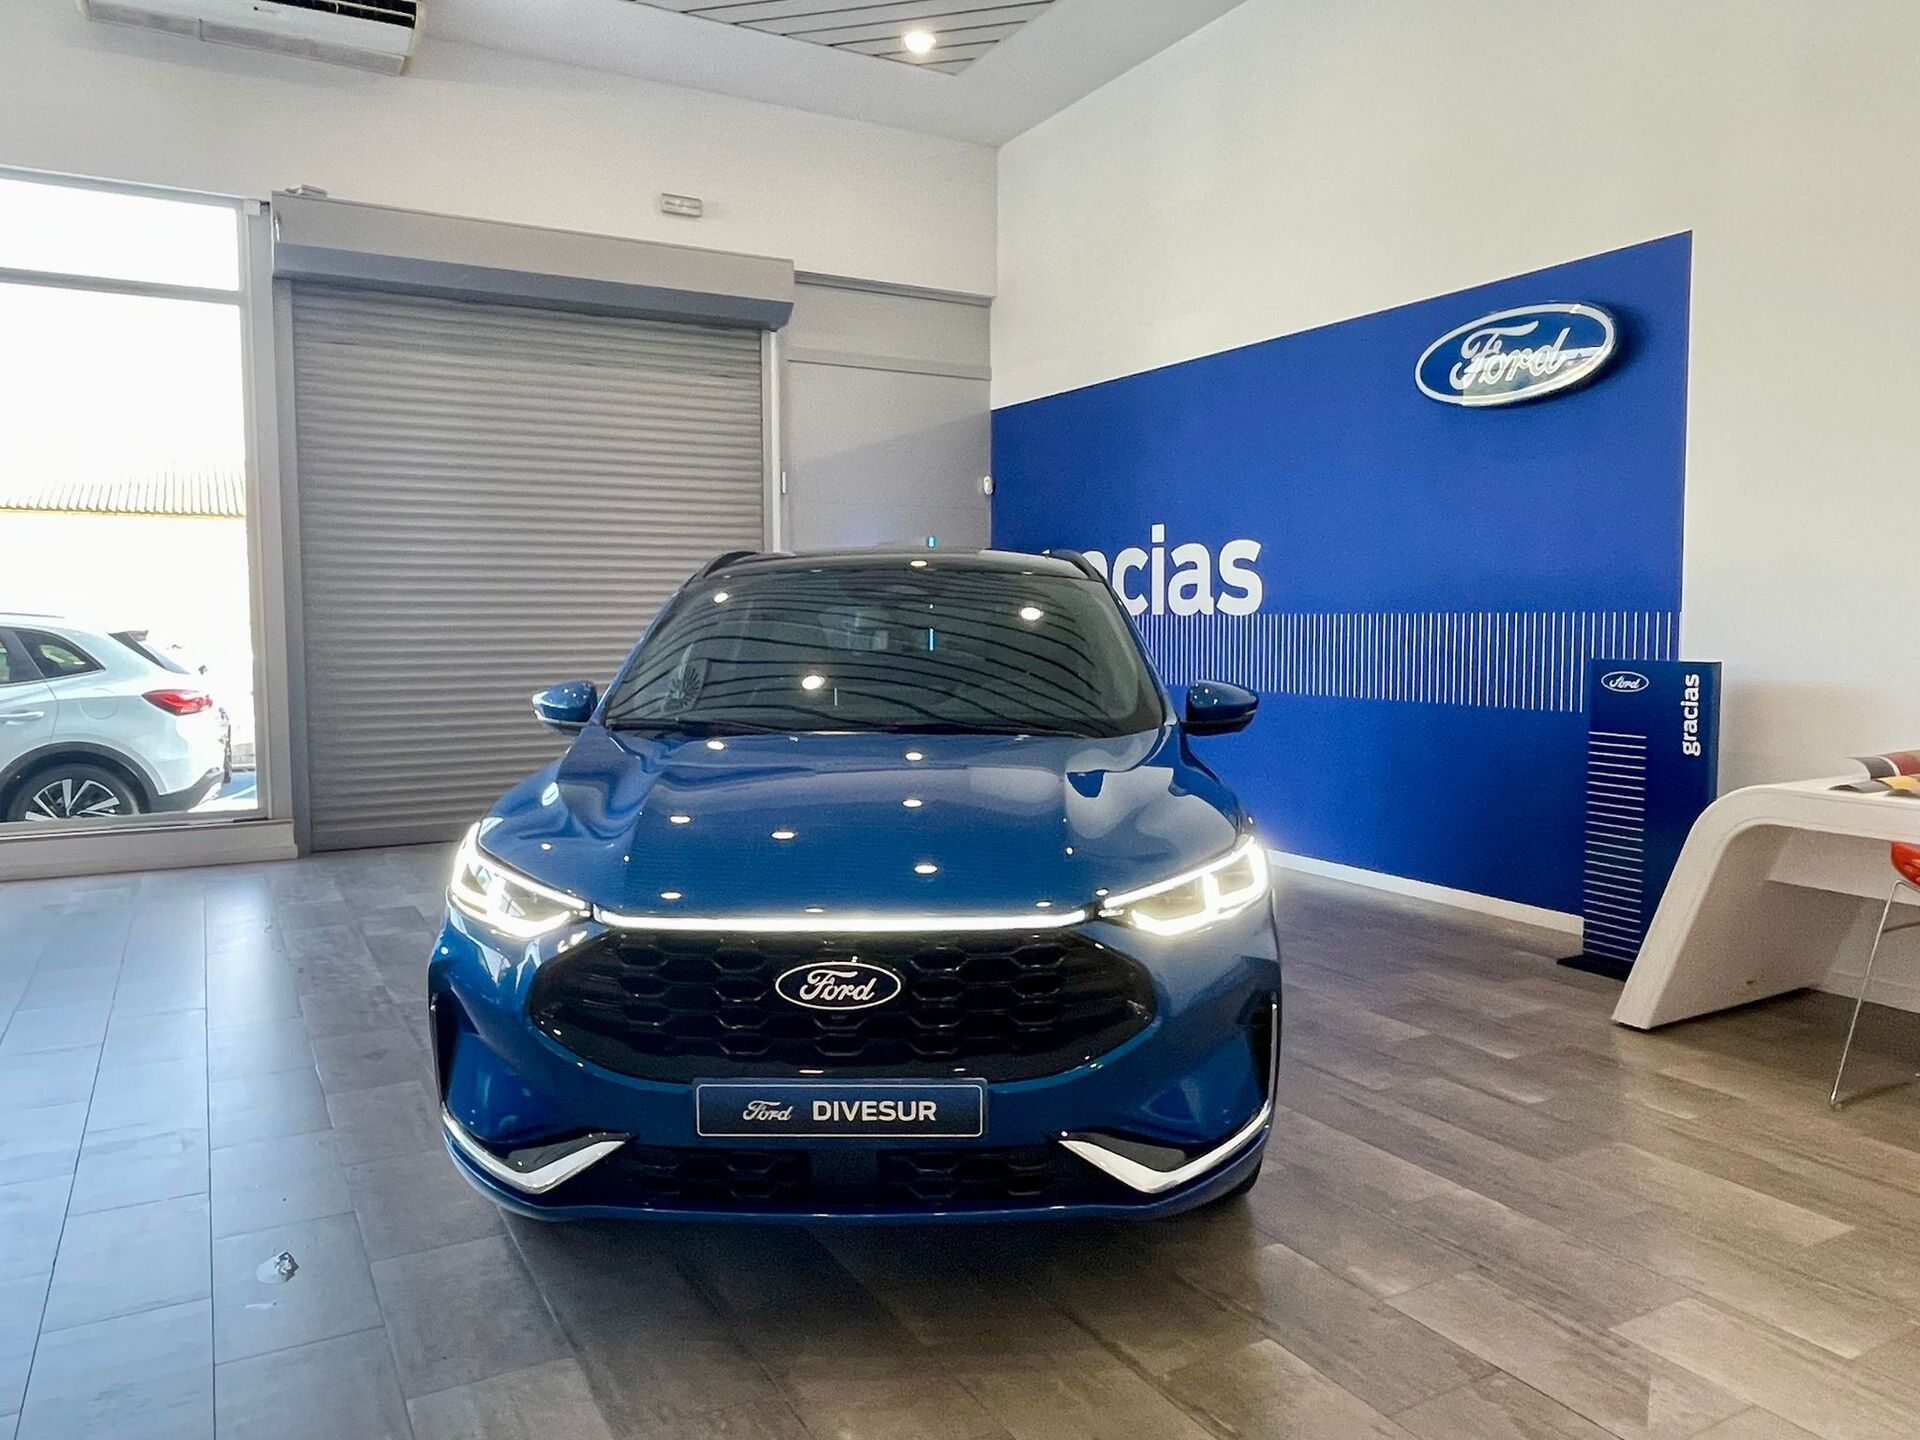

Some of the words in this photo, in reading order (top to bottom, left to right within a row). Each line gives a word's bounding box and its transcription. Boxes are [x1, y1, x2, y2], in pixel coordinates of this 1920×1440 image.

[1450, 320, 1570, 390] Ford
[1081, 523, 1263, 616] cias
[1609, 675, 1640, 689] Ford
[1680, 674, 1701, 757] gracias
[799, 969, 878, 1001] Ford
[742, 1100, 795, 1121] Ford
[812, 1100, 937, 1121] DIVESUR
